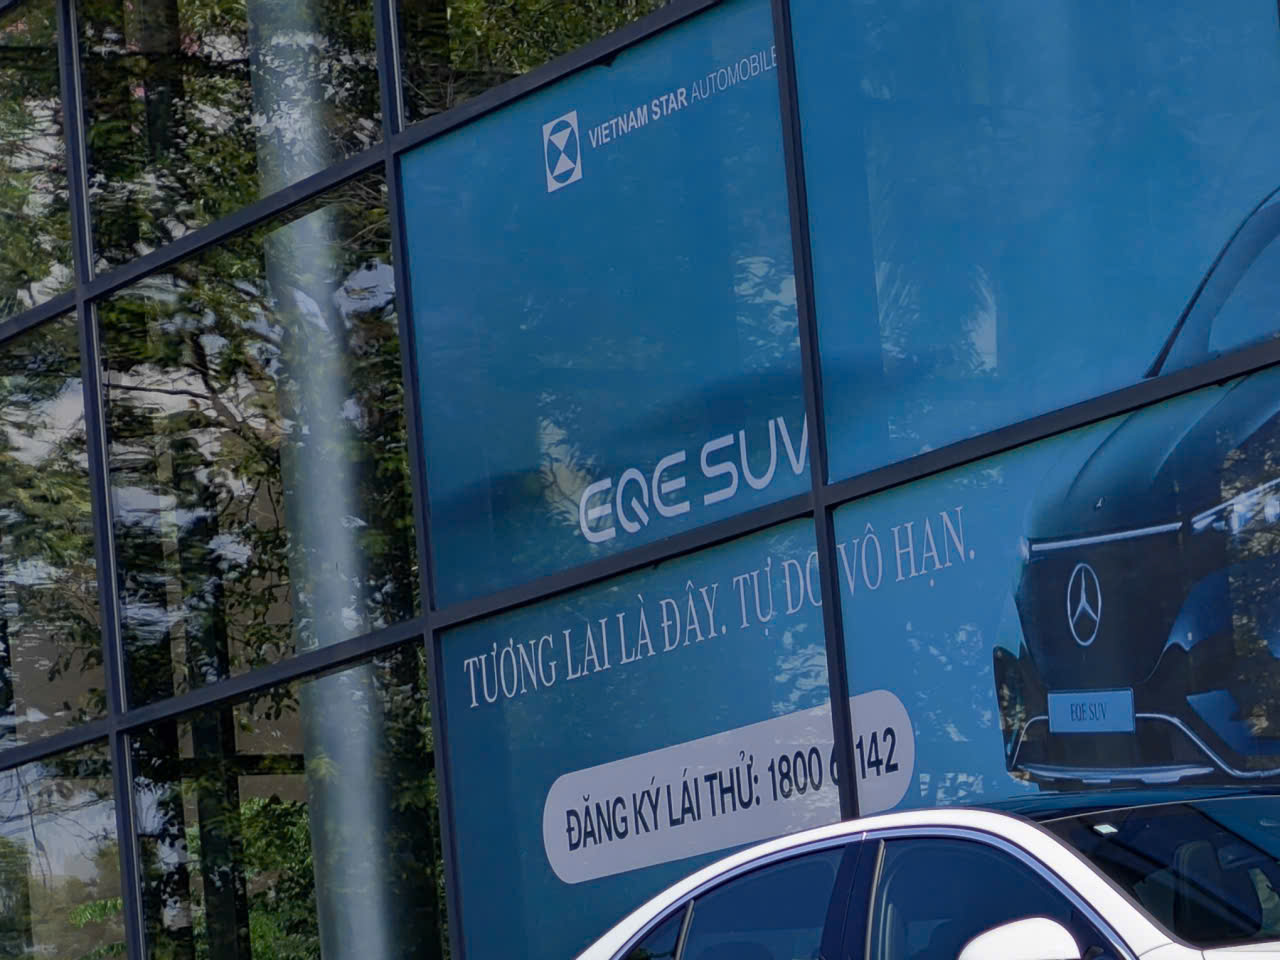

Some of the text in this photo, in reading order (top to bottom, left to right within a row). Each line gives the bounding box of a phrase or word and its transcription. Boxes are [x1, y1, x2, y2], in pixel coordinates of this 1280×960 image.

[588, 45, 778, 148] VIETNAM STAR AUTOMOBILE
[579, 411, 808, 543] EQE SUV
[463, 633, 557, 708] TƯƠNG
[563, 617, 611, 681] LAI
[616, 594, 656, 665] LÀ
[658, 579, 727, 652] ĐÂY.
[733, 556, 774, 637] TỰ
[836, 522, 883, 597] VÔ
[890, 506, 975, 587] HẠN.
[566, 793, 629, 852] ĐĂNG
[632, 775, 661, 836] KÝ
[666, 767, 702, 828] LÁI
[704, 750, 761, 817] THỬ:
[767, 746, 823, 801] 1800
